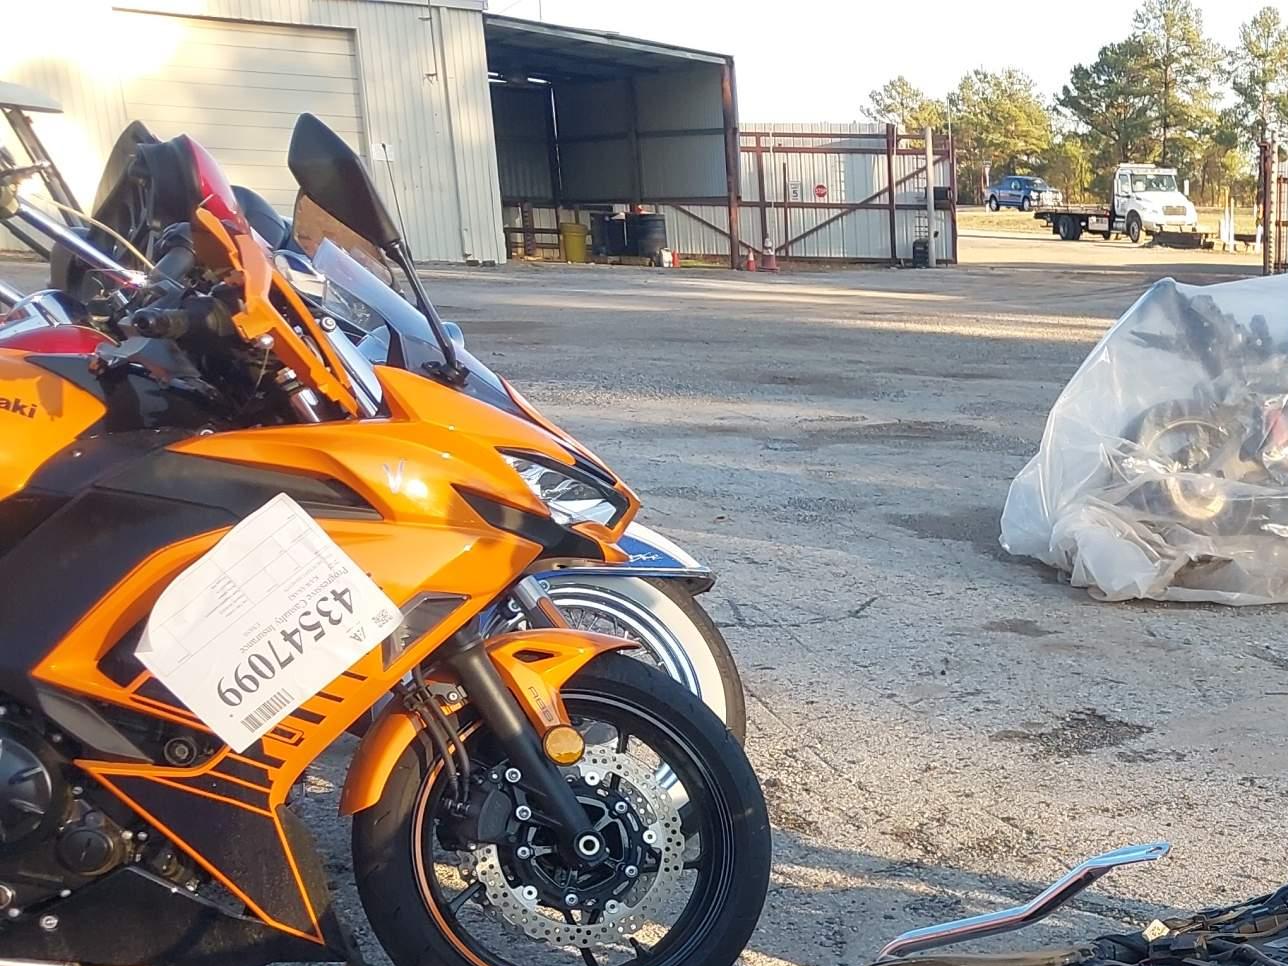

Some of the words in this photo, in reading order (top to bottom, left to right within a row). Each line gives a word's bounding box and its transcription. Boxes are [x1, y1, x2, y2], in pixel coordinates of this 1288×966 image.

[792, 190, 799, 198] 5
[0, 398, 38, 418] aki
[306, 566, 349, 601] Progressive
[274, 598, 308, 625] Casualty
[217, 588, 354, 707] 43547099
[240, 626, 276, 654] Insurance
